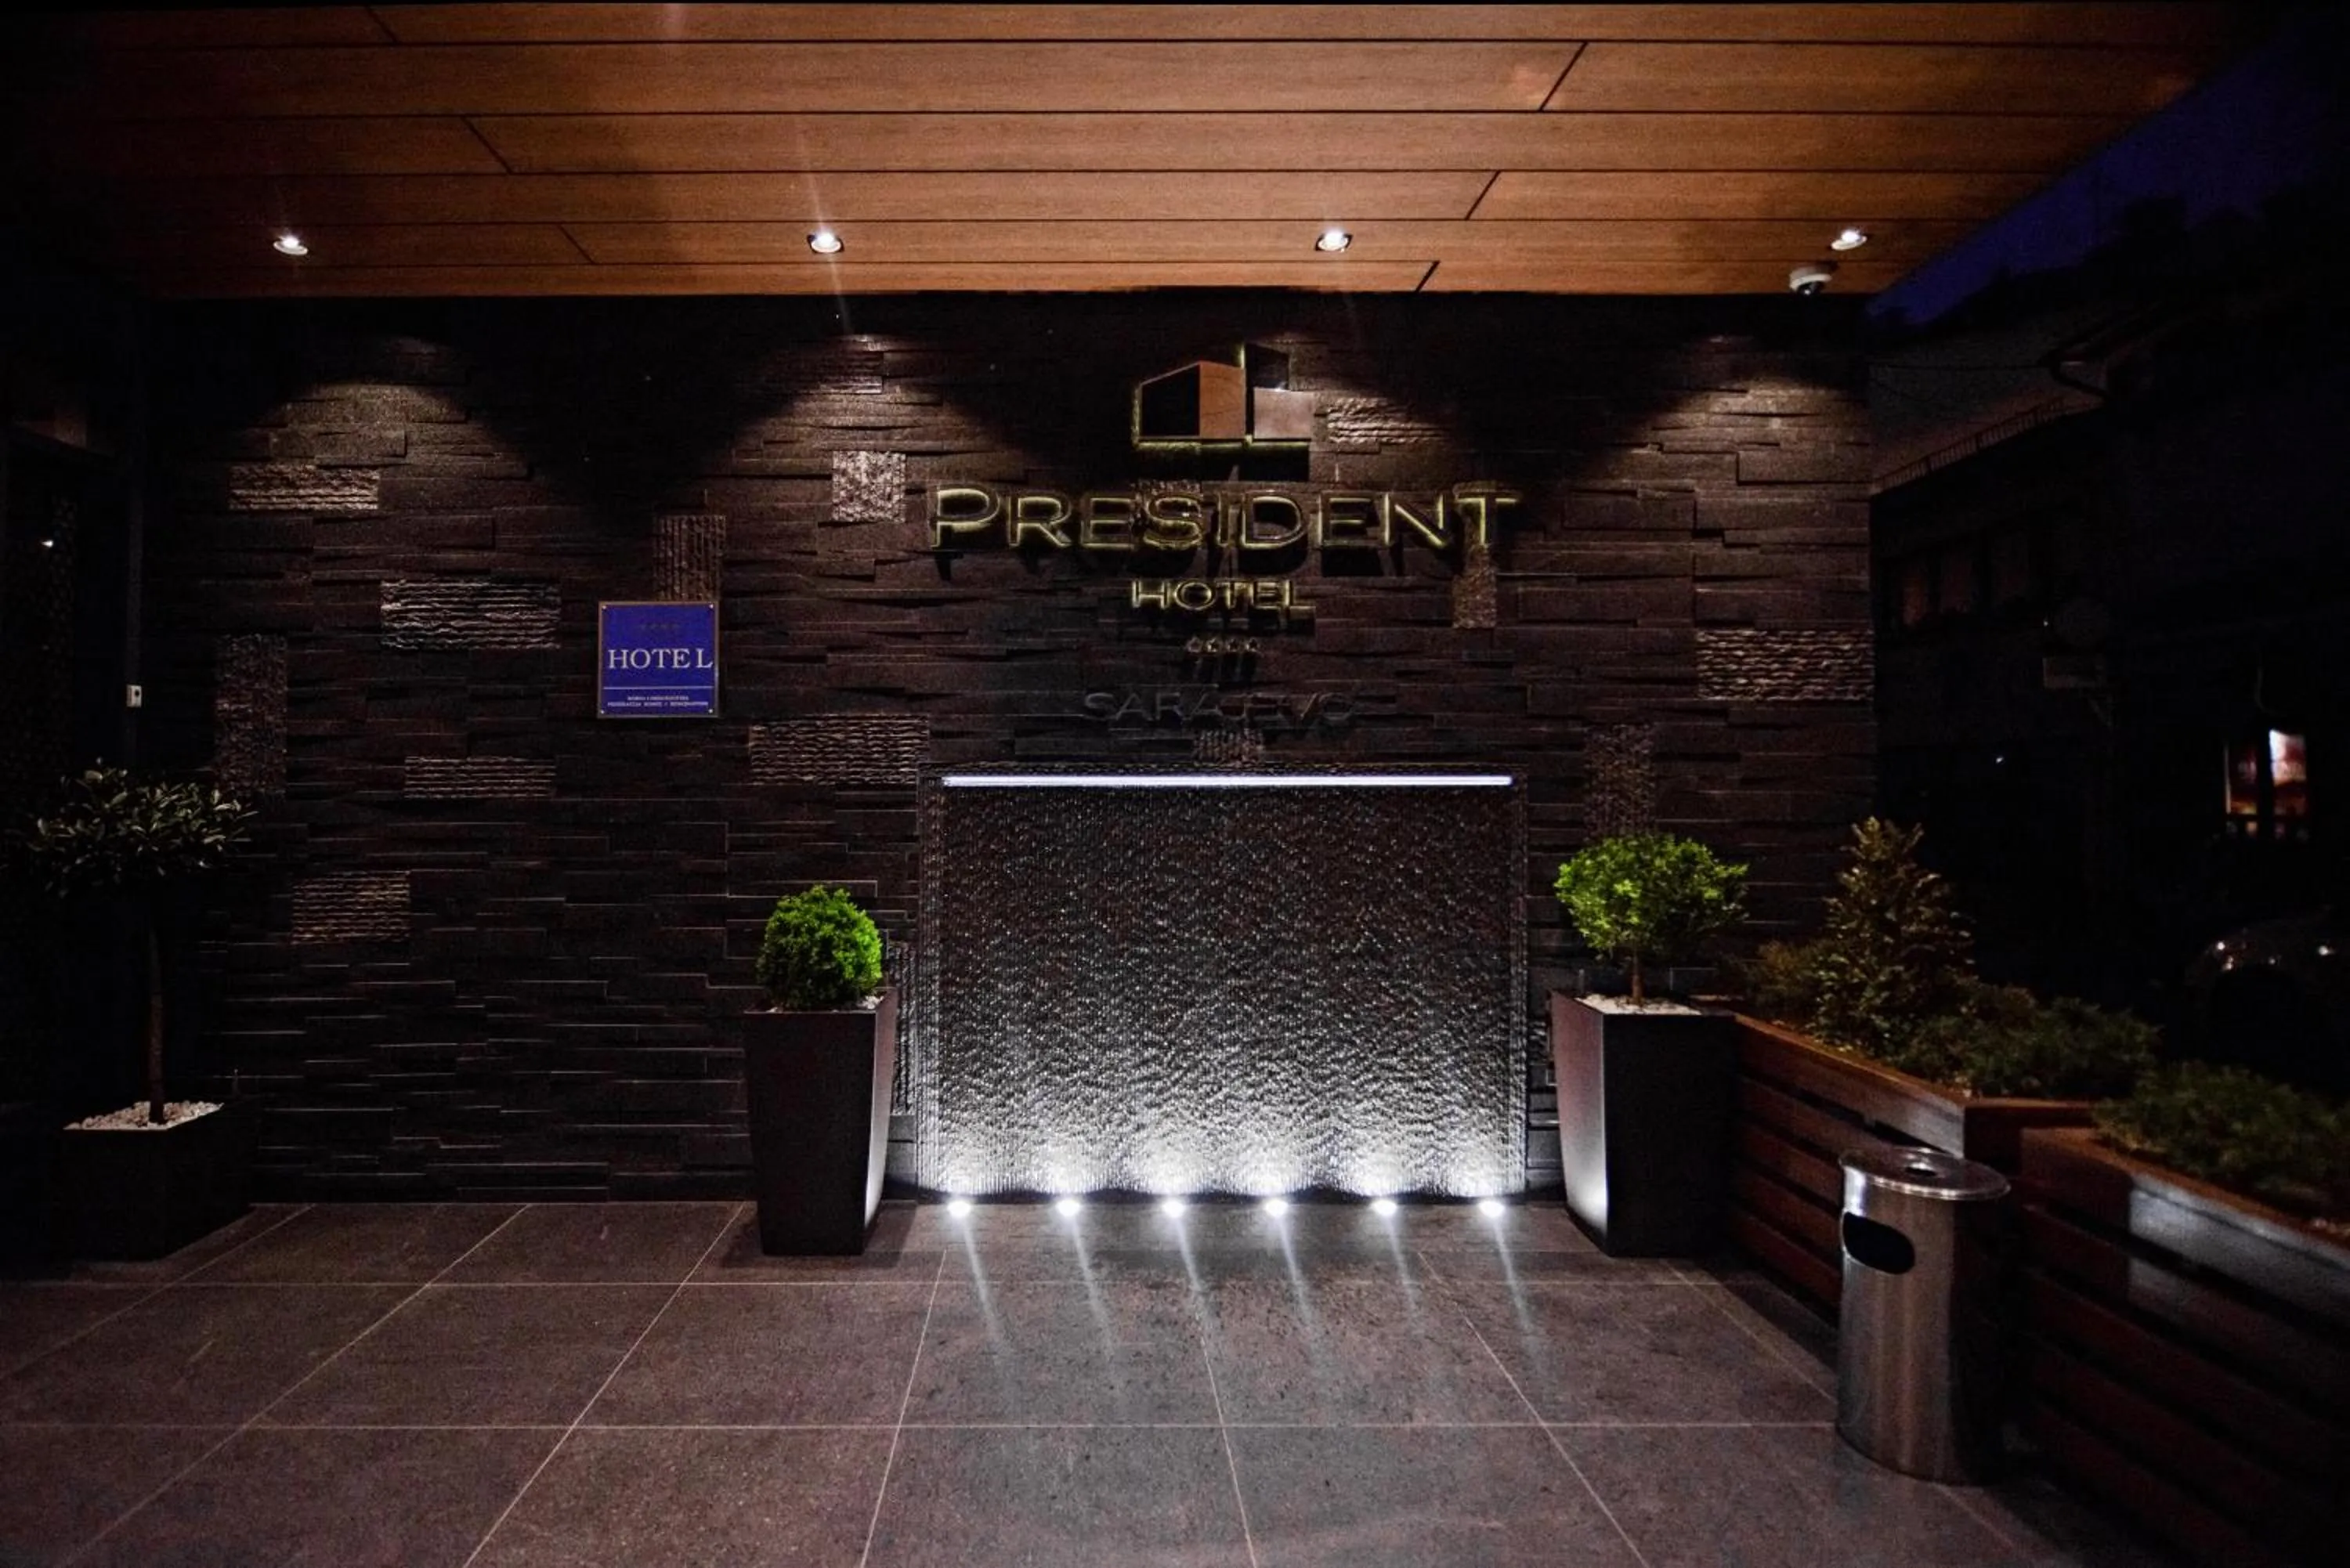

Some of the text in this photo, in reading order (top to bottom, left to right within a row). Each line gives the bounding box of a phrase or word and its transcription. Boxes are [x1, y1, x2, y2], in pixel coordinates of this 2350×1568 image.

[931, 485, 1522, 550] PRESIDENT
[1130, 579, 1315, 613] HOTEL
[608, 648, 714, 669] HOTEL
